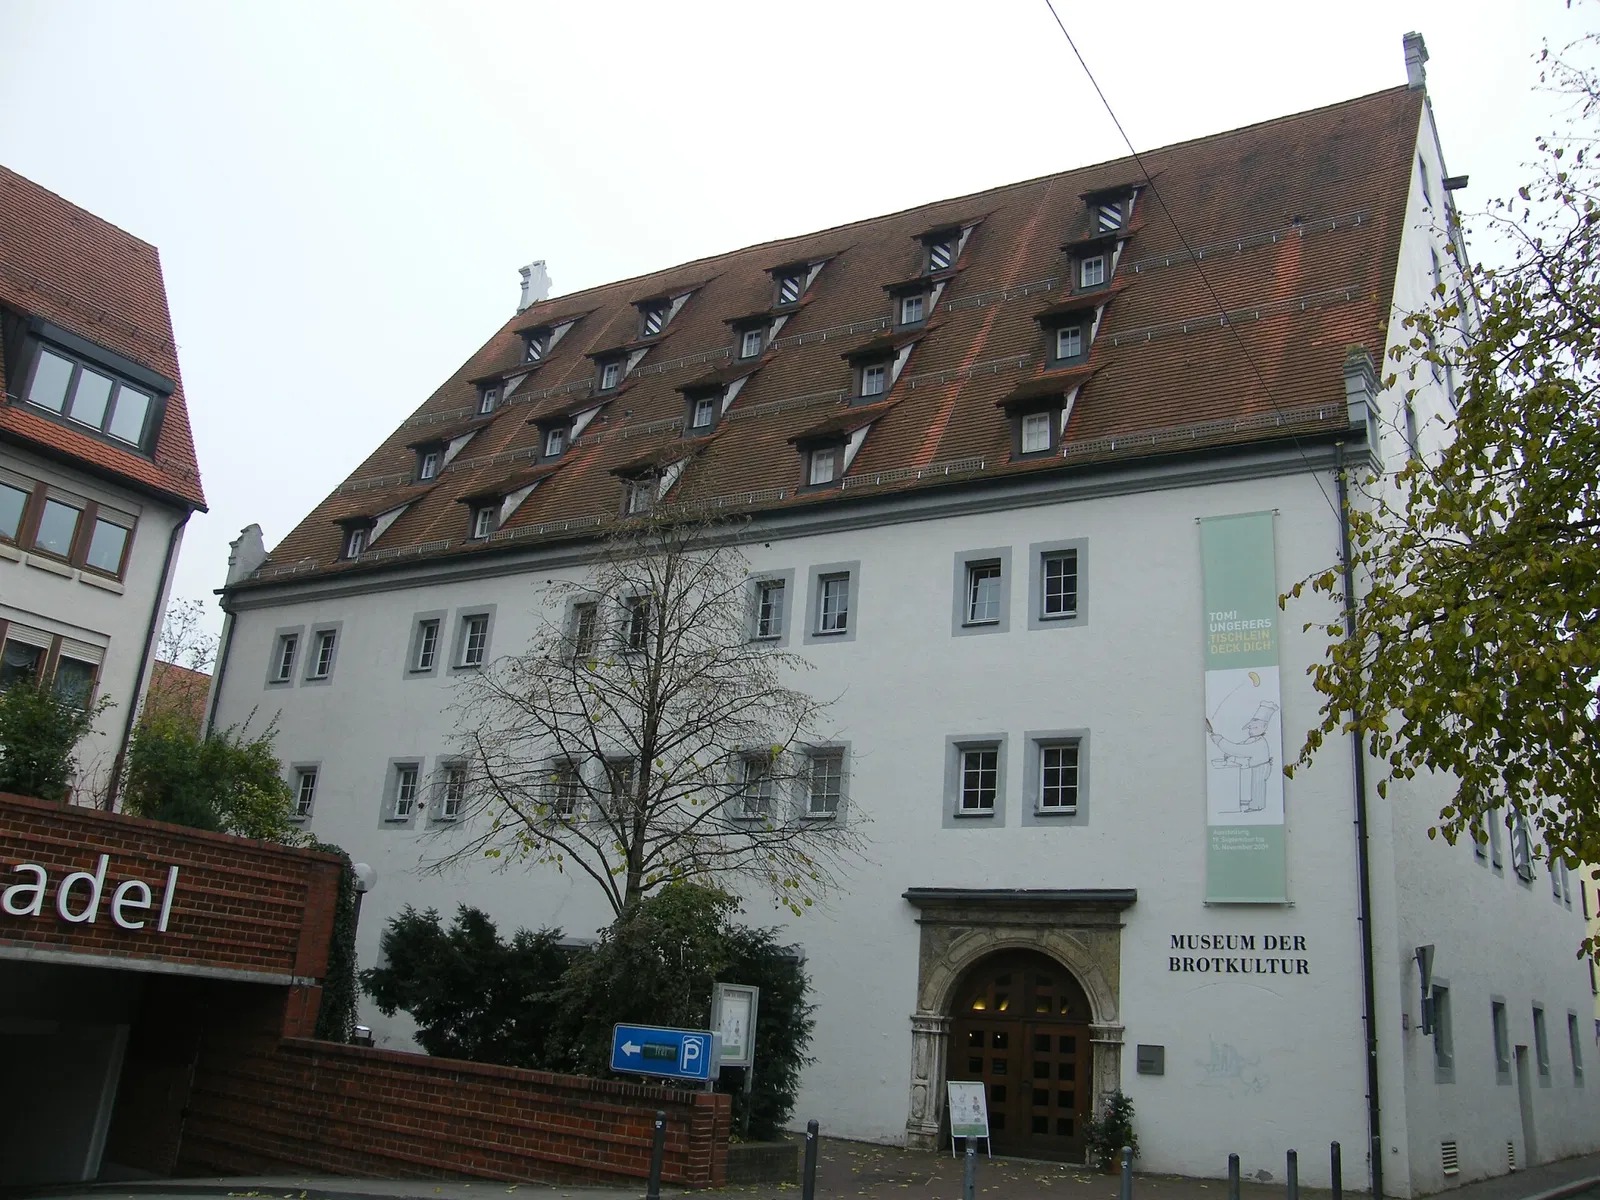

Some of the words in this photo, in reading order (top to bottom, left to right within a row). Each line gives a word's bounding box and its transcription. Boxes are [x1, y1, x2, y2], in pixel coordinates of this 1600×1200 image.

[1209, 610, 1237, 621] TOMI
[1209, 618, 1272, 632] UNGERERS
[1210, 643, 1240, 654] DECK
[0, 854, 179, 932] adel
[1170, 934, 1255, 950] MUSEUM
[1263, 935, 1307, 951] DER
[1168, 956, 1310, 975] BROTKULTUR
[683, 1044, 700, 1070] P
